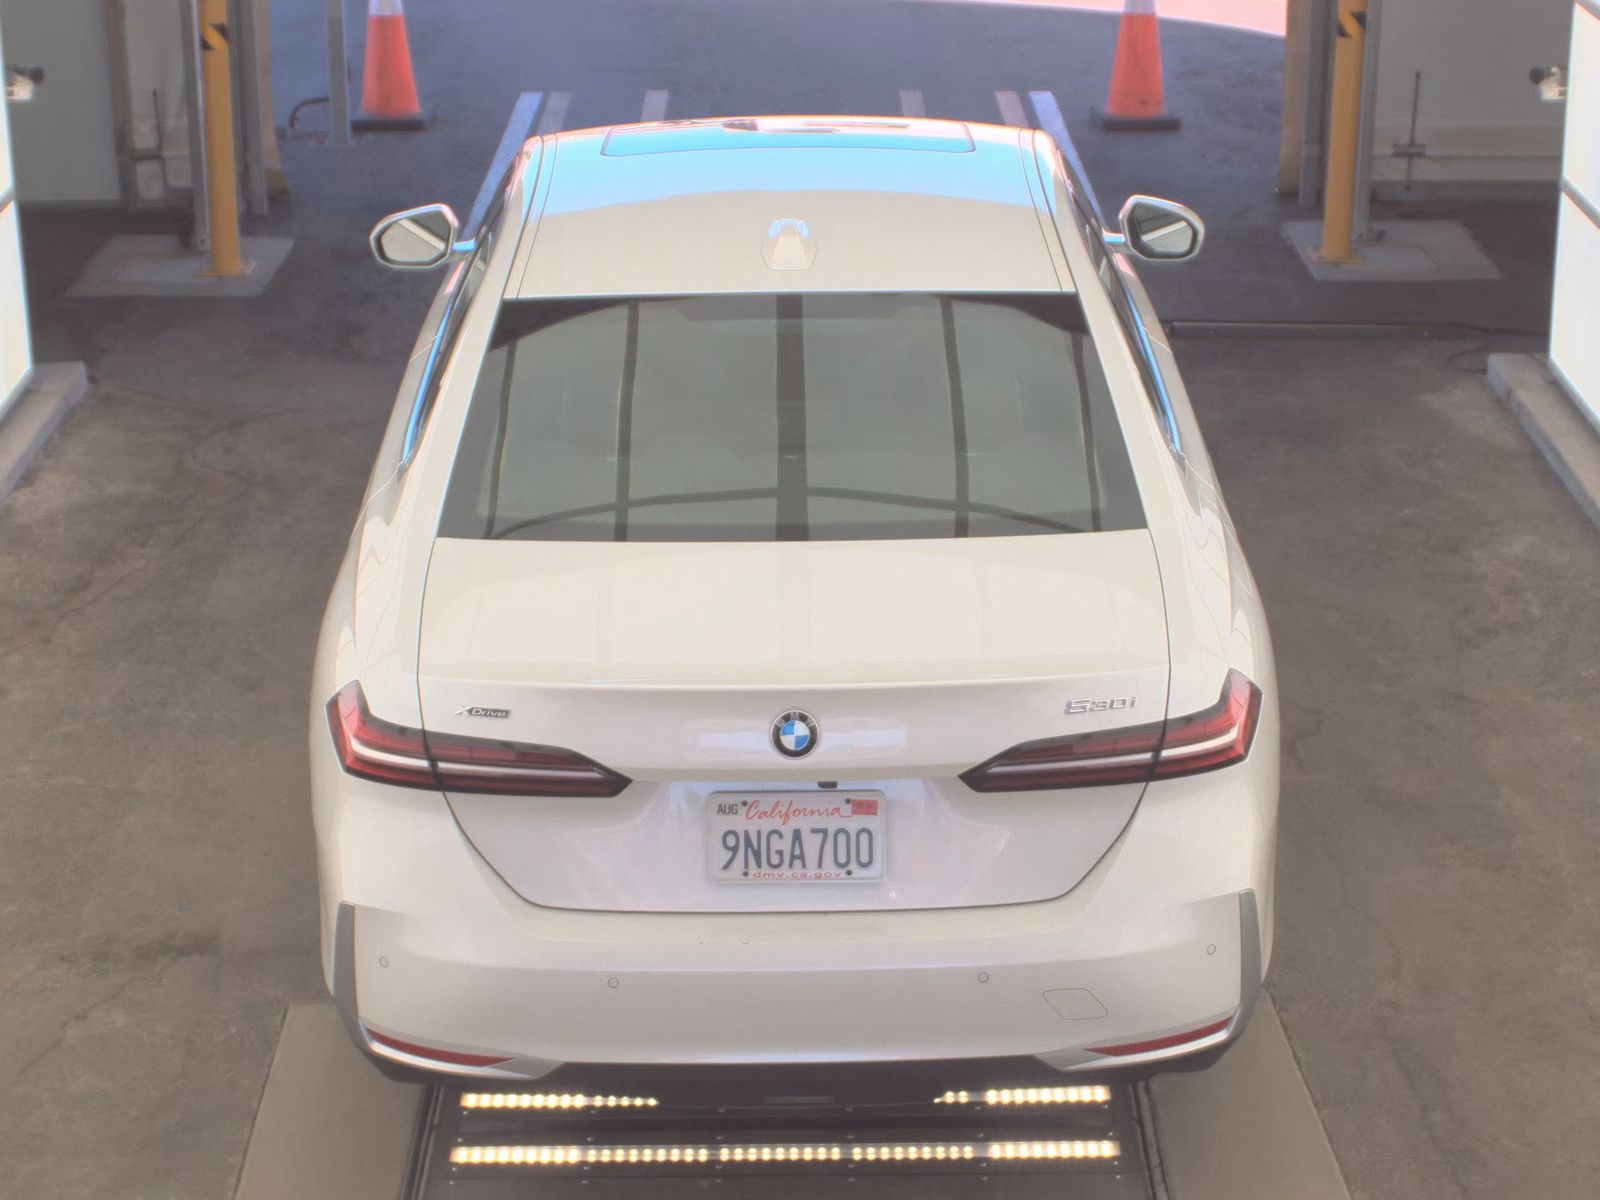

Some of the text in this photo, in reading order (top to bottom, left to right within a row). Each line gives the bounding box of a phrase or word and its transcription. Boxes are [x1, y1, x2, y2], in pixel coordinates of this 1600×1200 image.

[775, 711, 815, 727] BMW
[716, 803, 738, 815] AUG
[746, 799, 852, 825] California
[721, 827, 874, 870] 9NGA700
[753, 871, 842, 879] dmv.ca.gov
